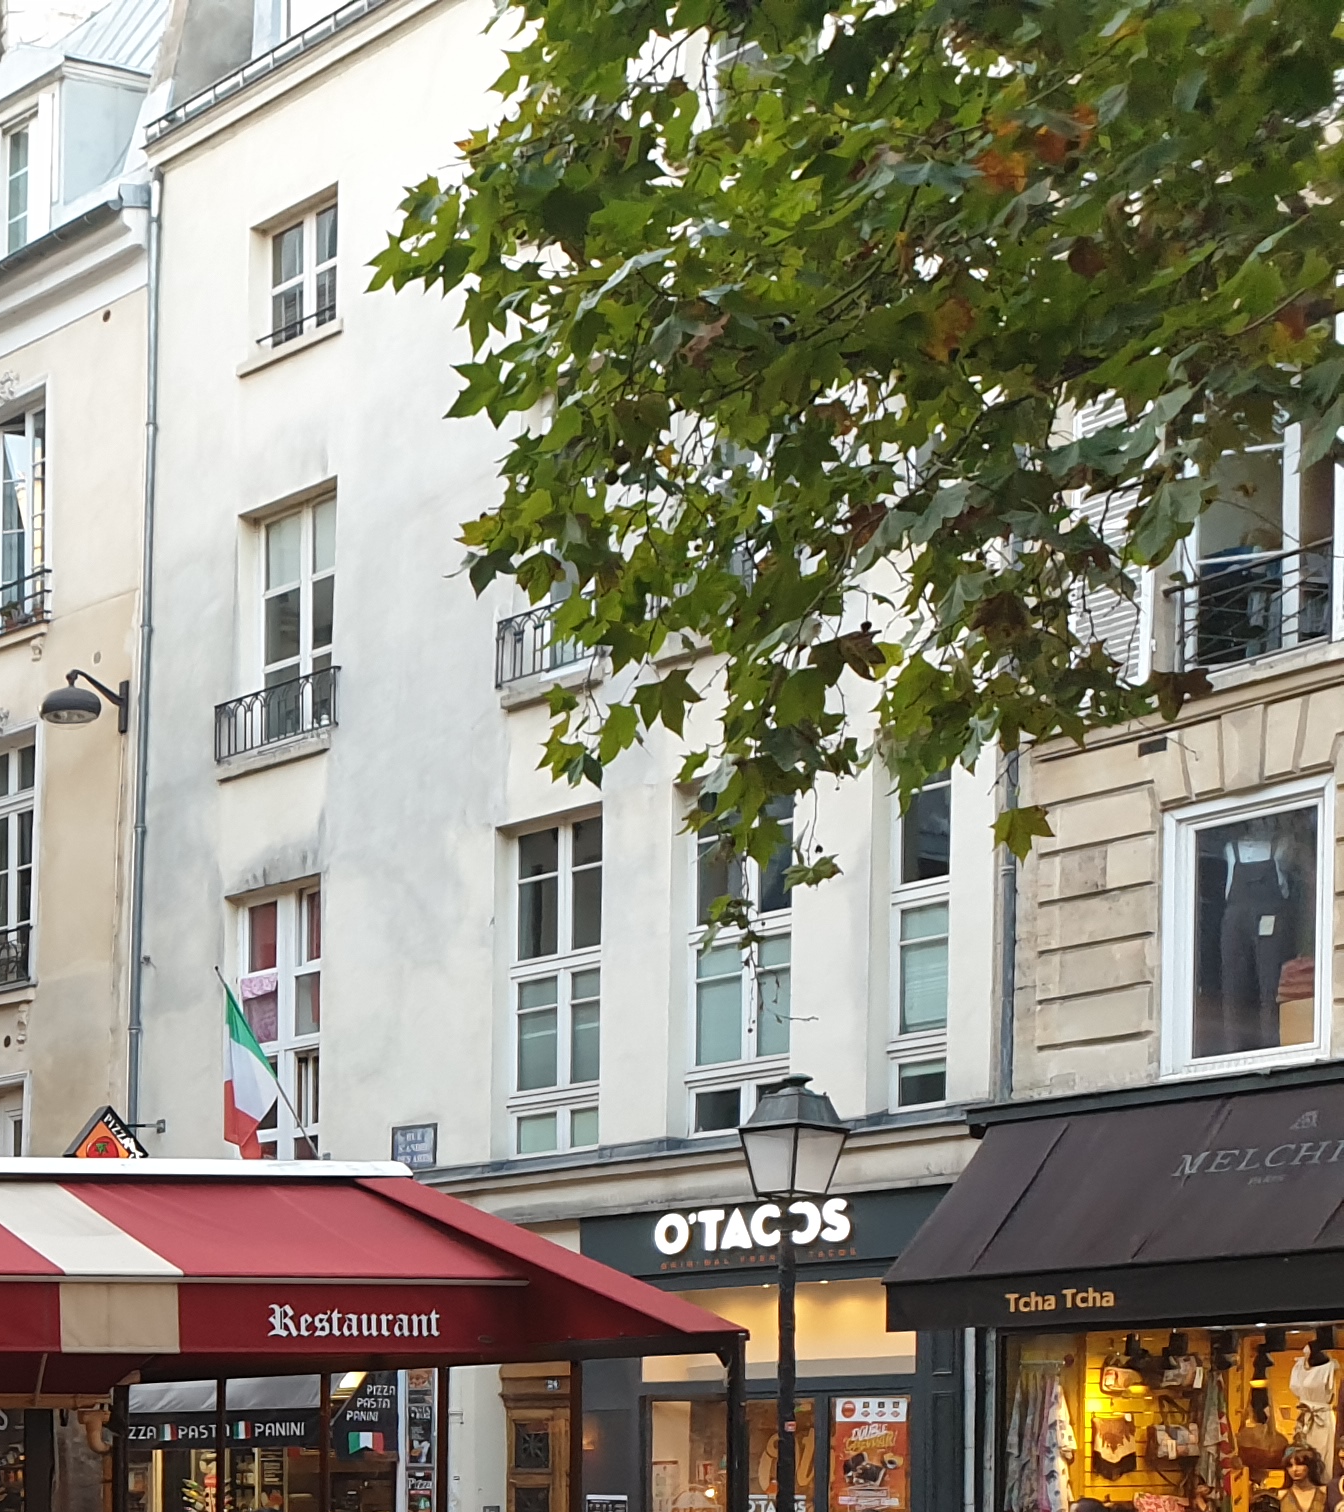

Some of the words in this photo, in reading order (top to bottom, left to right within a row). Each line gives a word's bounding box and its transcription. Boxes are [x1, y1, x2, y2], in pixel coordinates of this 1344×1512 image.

[654, 1198, 851, 1255] O'TACOS
[1004, 1291, 1057, 1313] Tcha
[1062, 1287, 1115, 1309] Tcha
[267, 1303, 442, 1338] Restaurant
[366, 1384, 396, 1396] PIZZA
[356, 1397, 391, 1409] PASTA
[346, 1410, 379, 1422] PANINI
[128, 1425, 157, 1440] ZZA
[254, 1421, 306, 1438] PANINI
